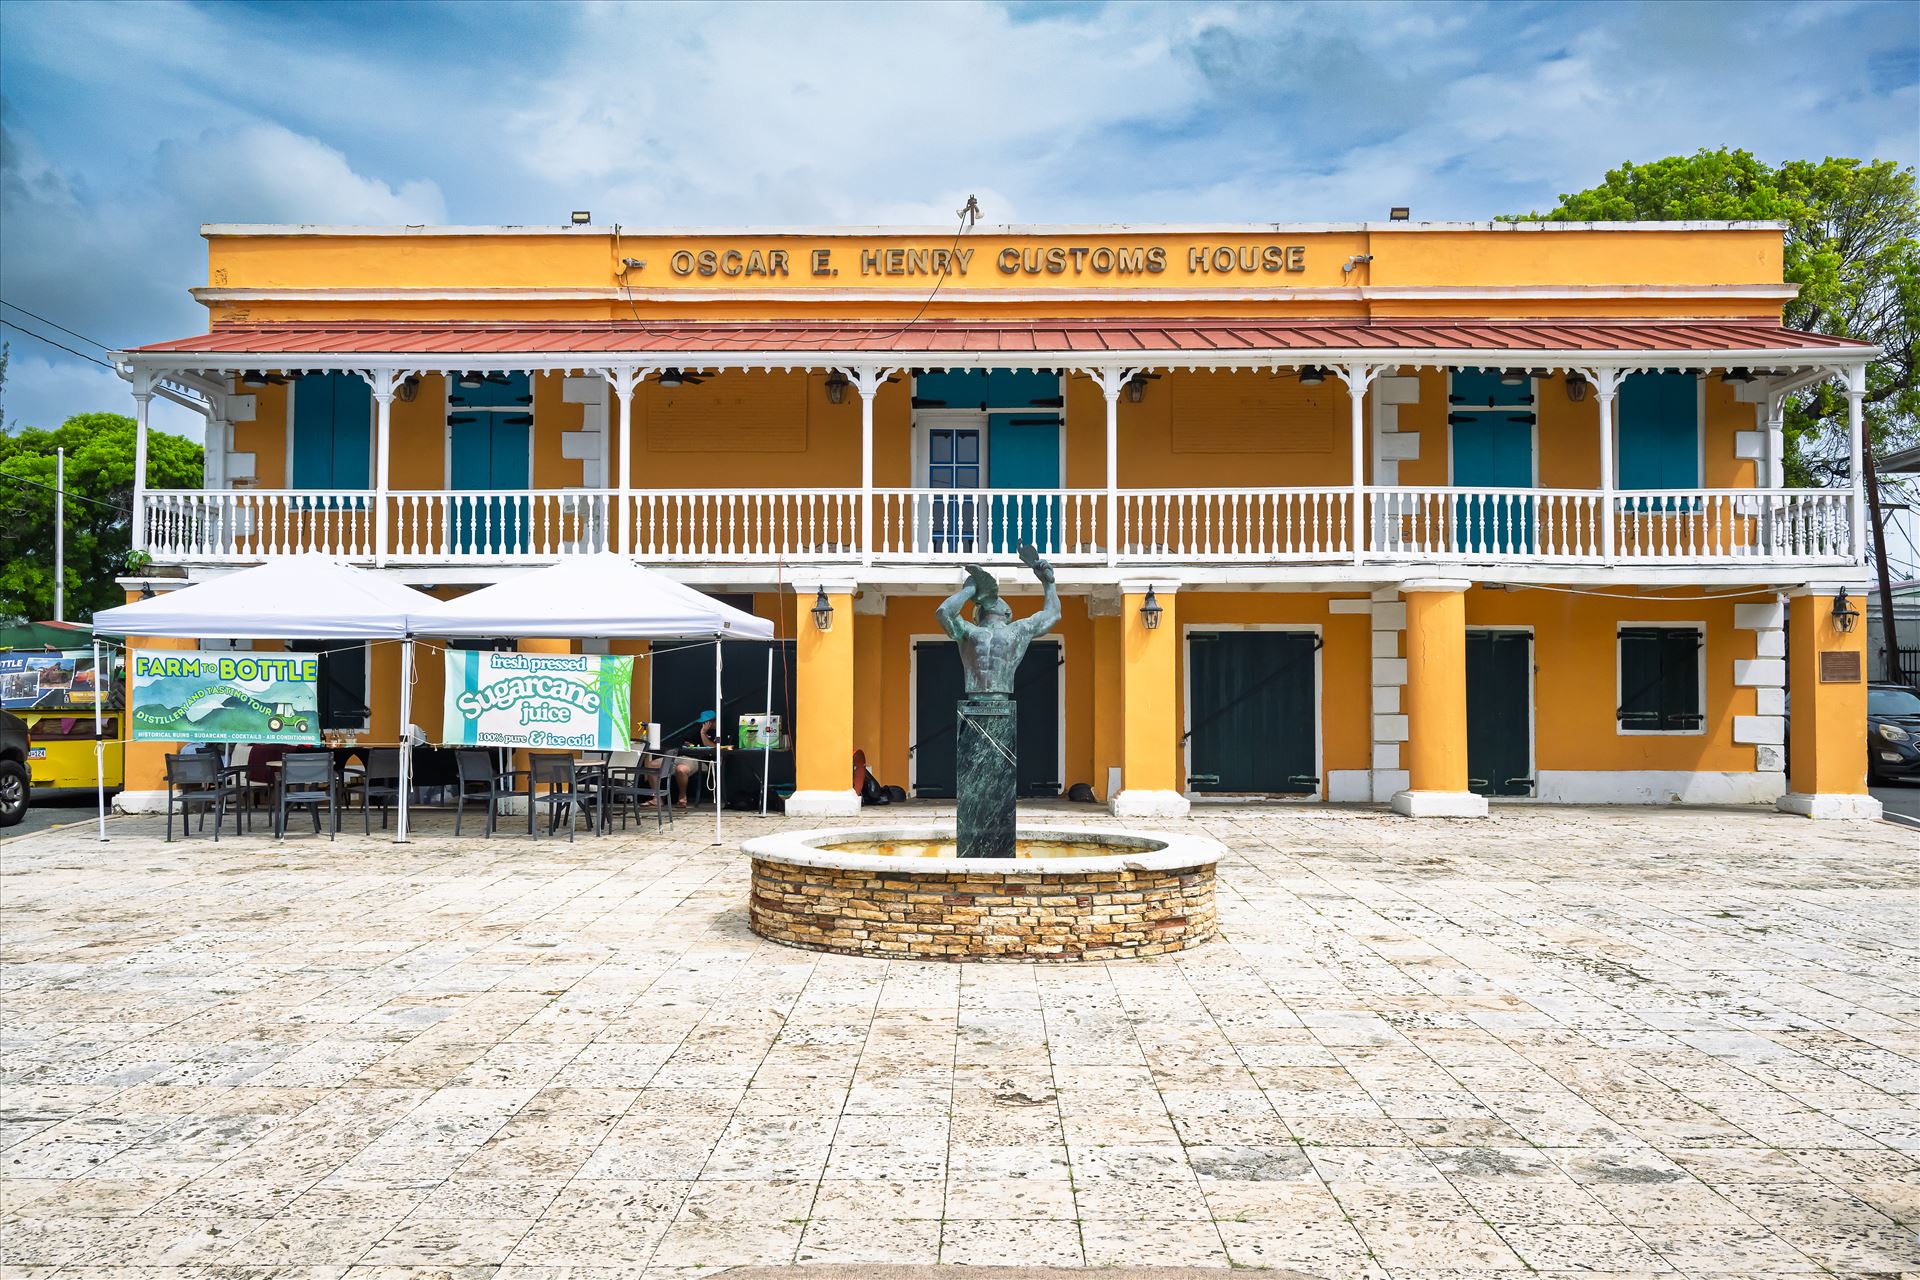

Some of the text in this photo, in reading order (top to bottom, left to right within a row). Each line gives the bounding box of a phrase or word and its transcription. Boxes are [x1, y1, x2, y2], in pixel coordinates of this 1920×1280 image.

[671, 246, 1306, 276] OSCAR E. HENRY CUSTOMS HOUSE
[0, 659, 23, 668] TTLE
[136, 657, 318, 682] FARM TO BOTTLE
[491, 654, 587, 672] fresh pressed
[136, 685, 273, 725] DISTILLERY AND TASTING TOUR
[456, 675, 601, 720] Sugarcane
[520, 701, 571, 725] juice
[478, 730, 595, 747] 100% pure & ice cold
